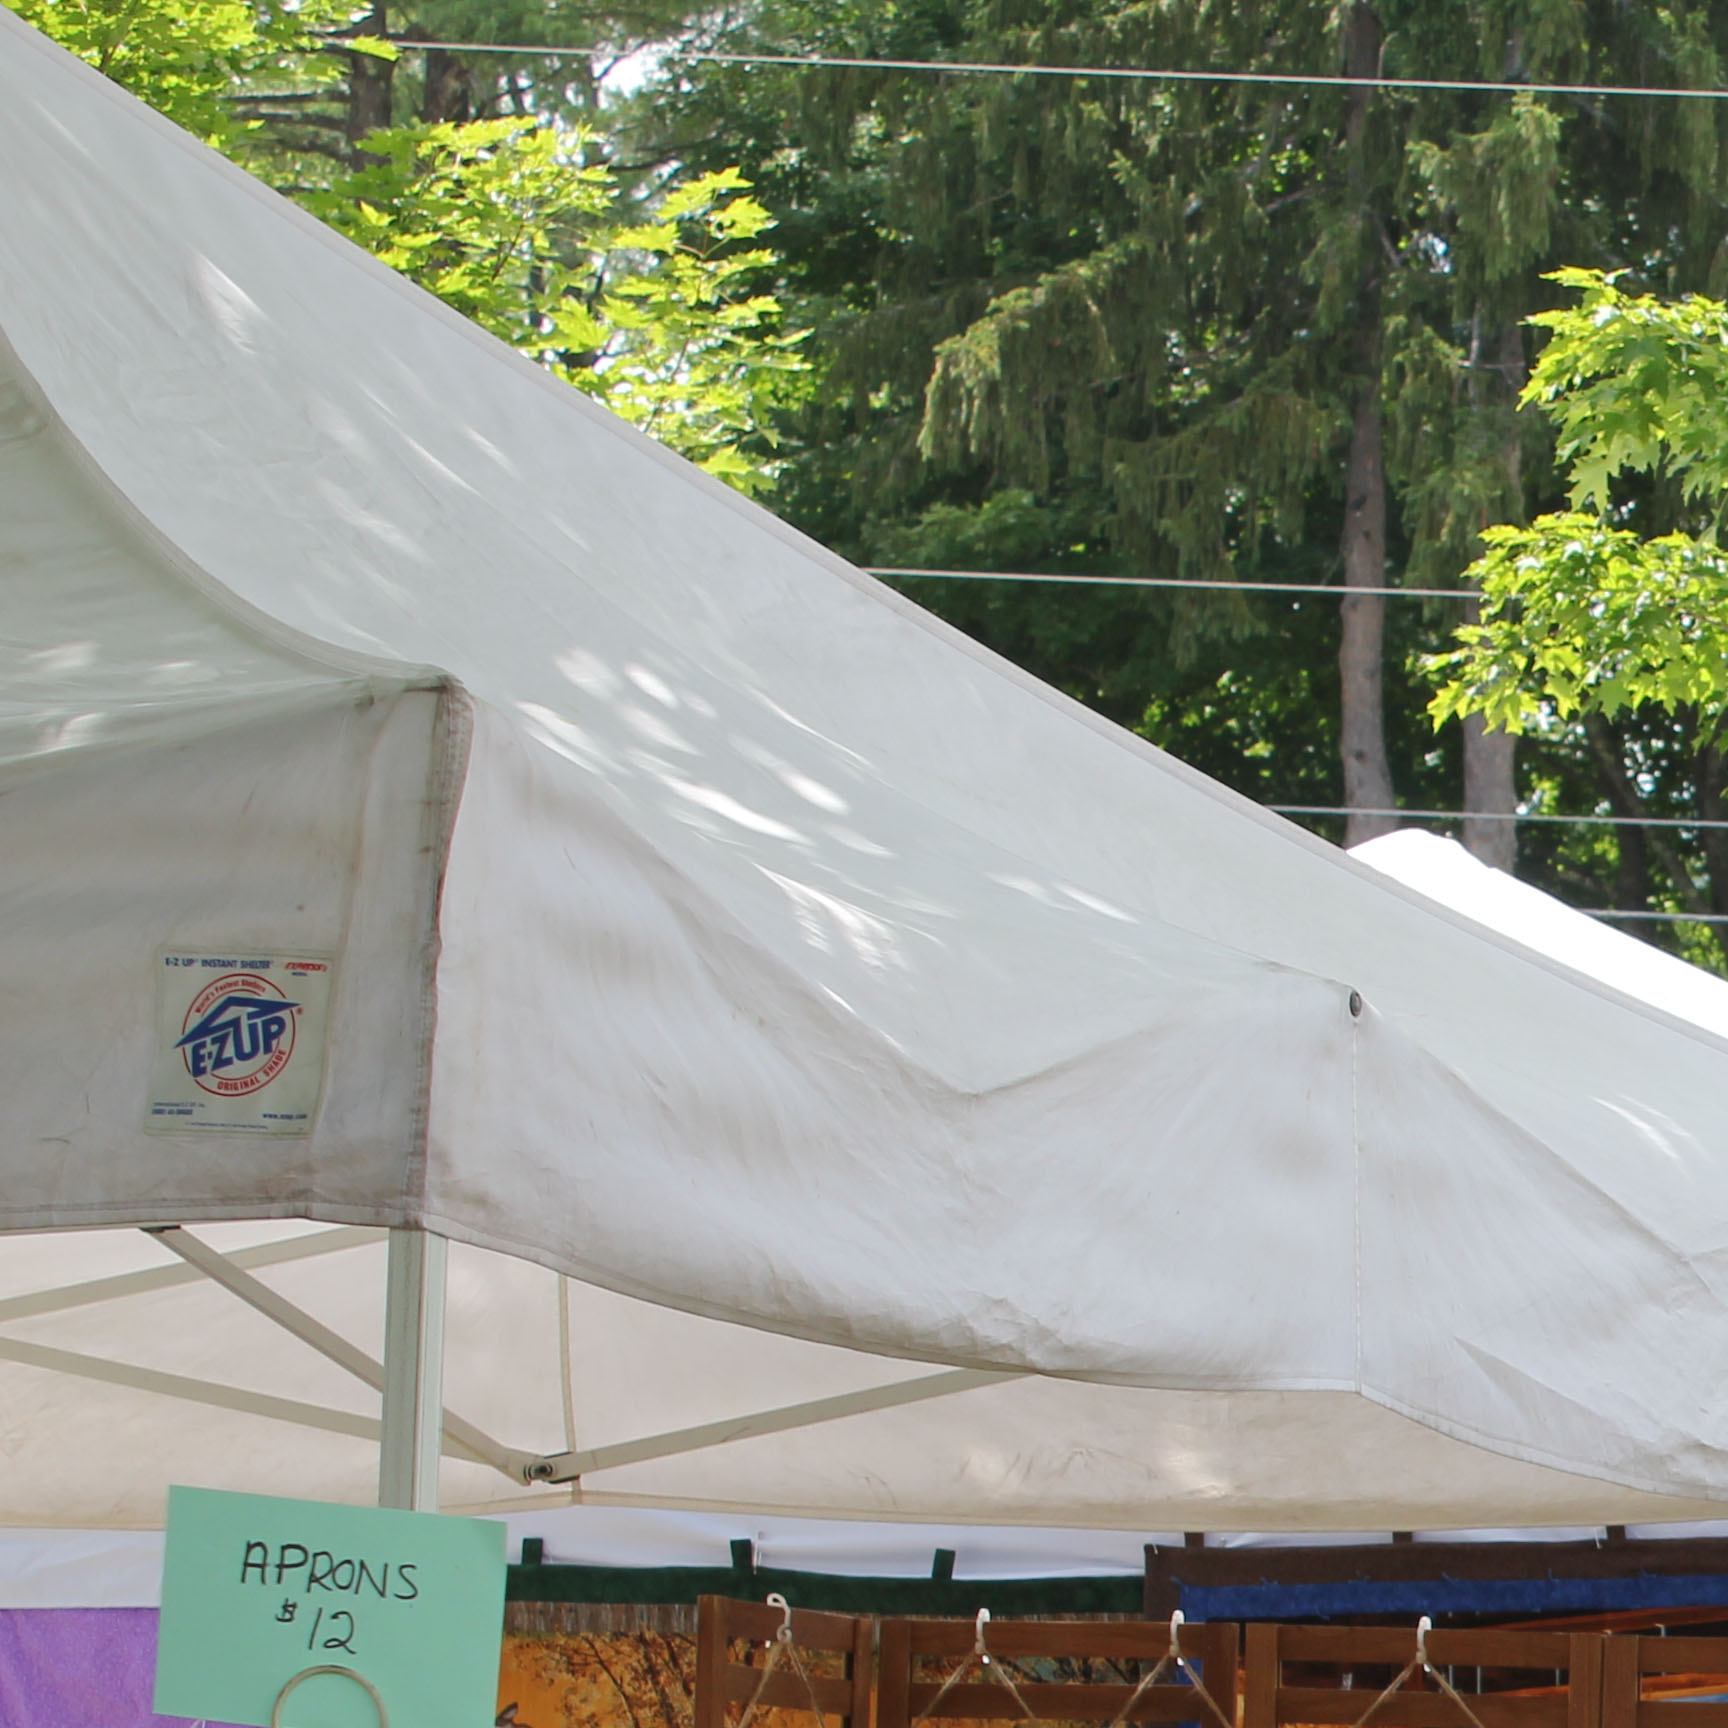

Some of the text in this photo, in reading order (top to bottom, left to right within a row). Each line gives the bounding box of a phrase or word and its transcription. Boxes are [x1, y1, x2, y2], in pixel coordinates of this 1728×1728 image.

[201, 958, 238, 969] INSTANT
[240, 959, 271, 970] SHELTER
[217, 1049, 287, 1092] ORIGINAL SHADE
[240, 1540, 419, 1601] APRONS
